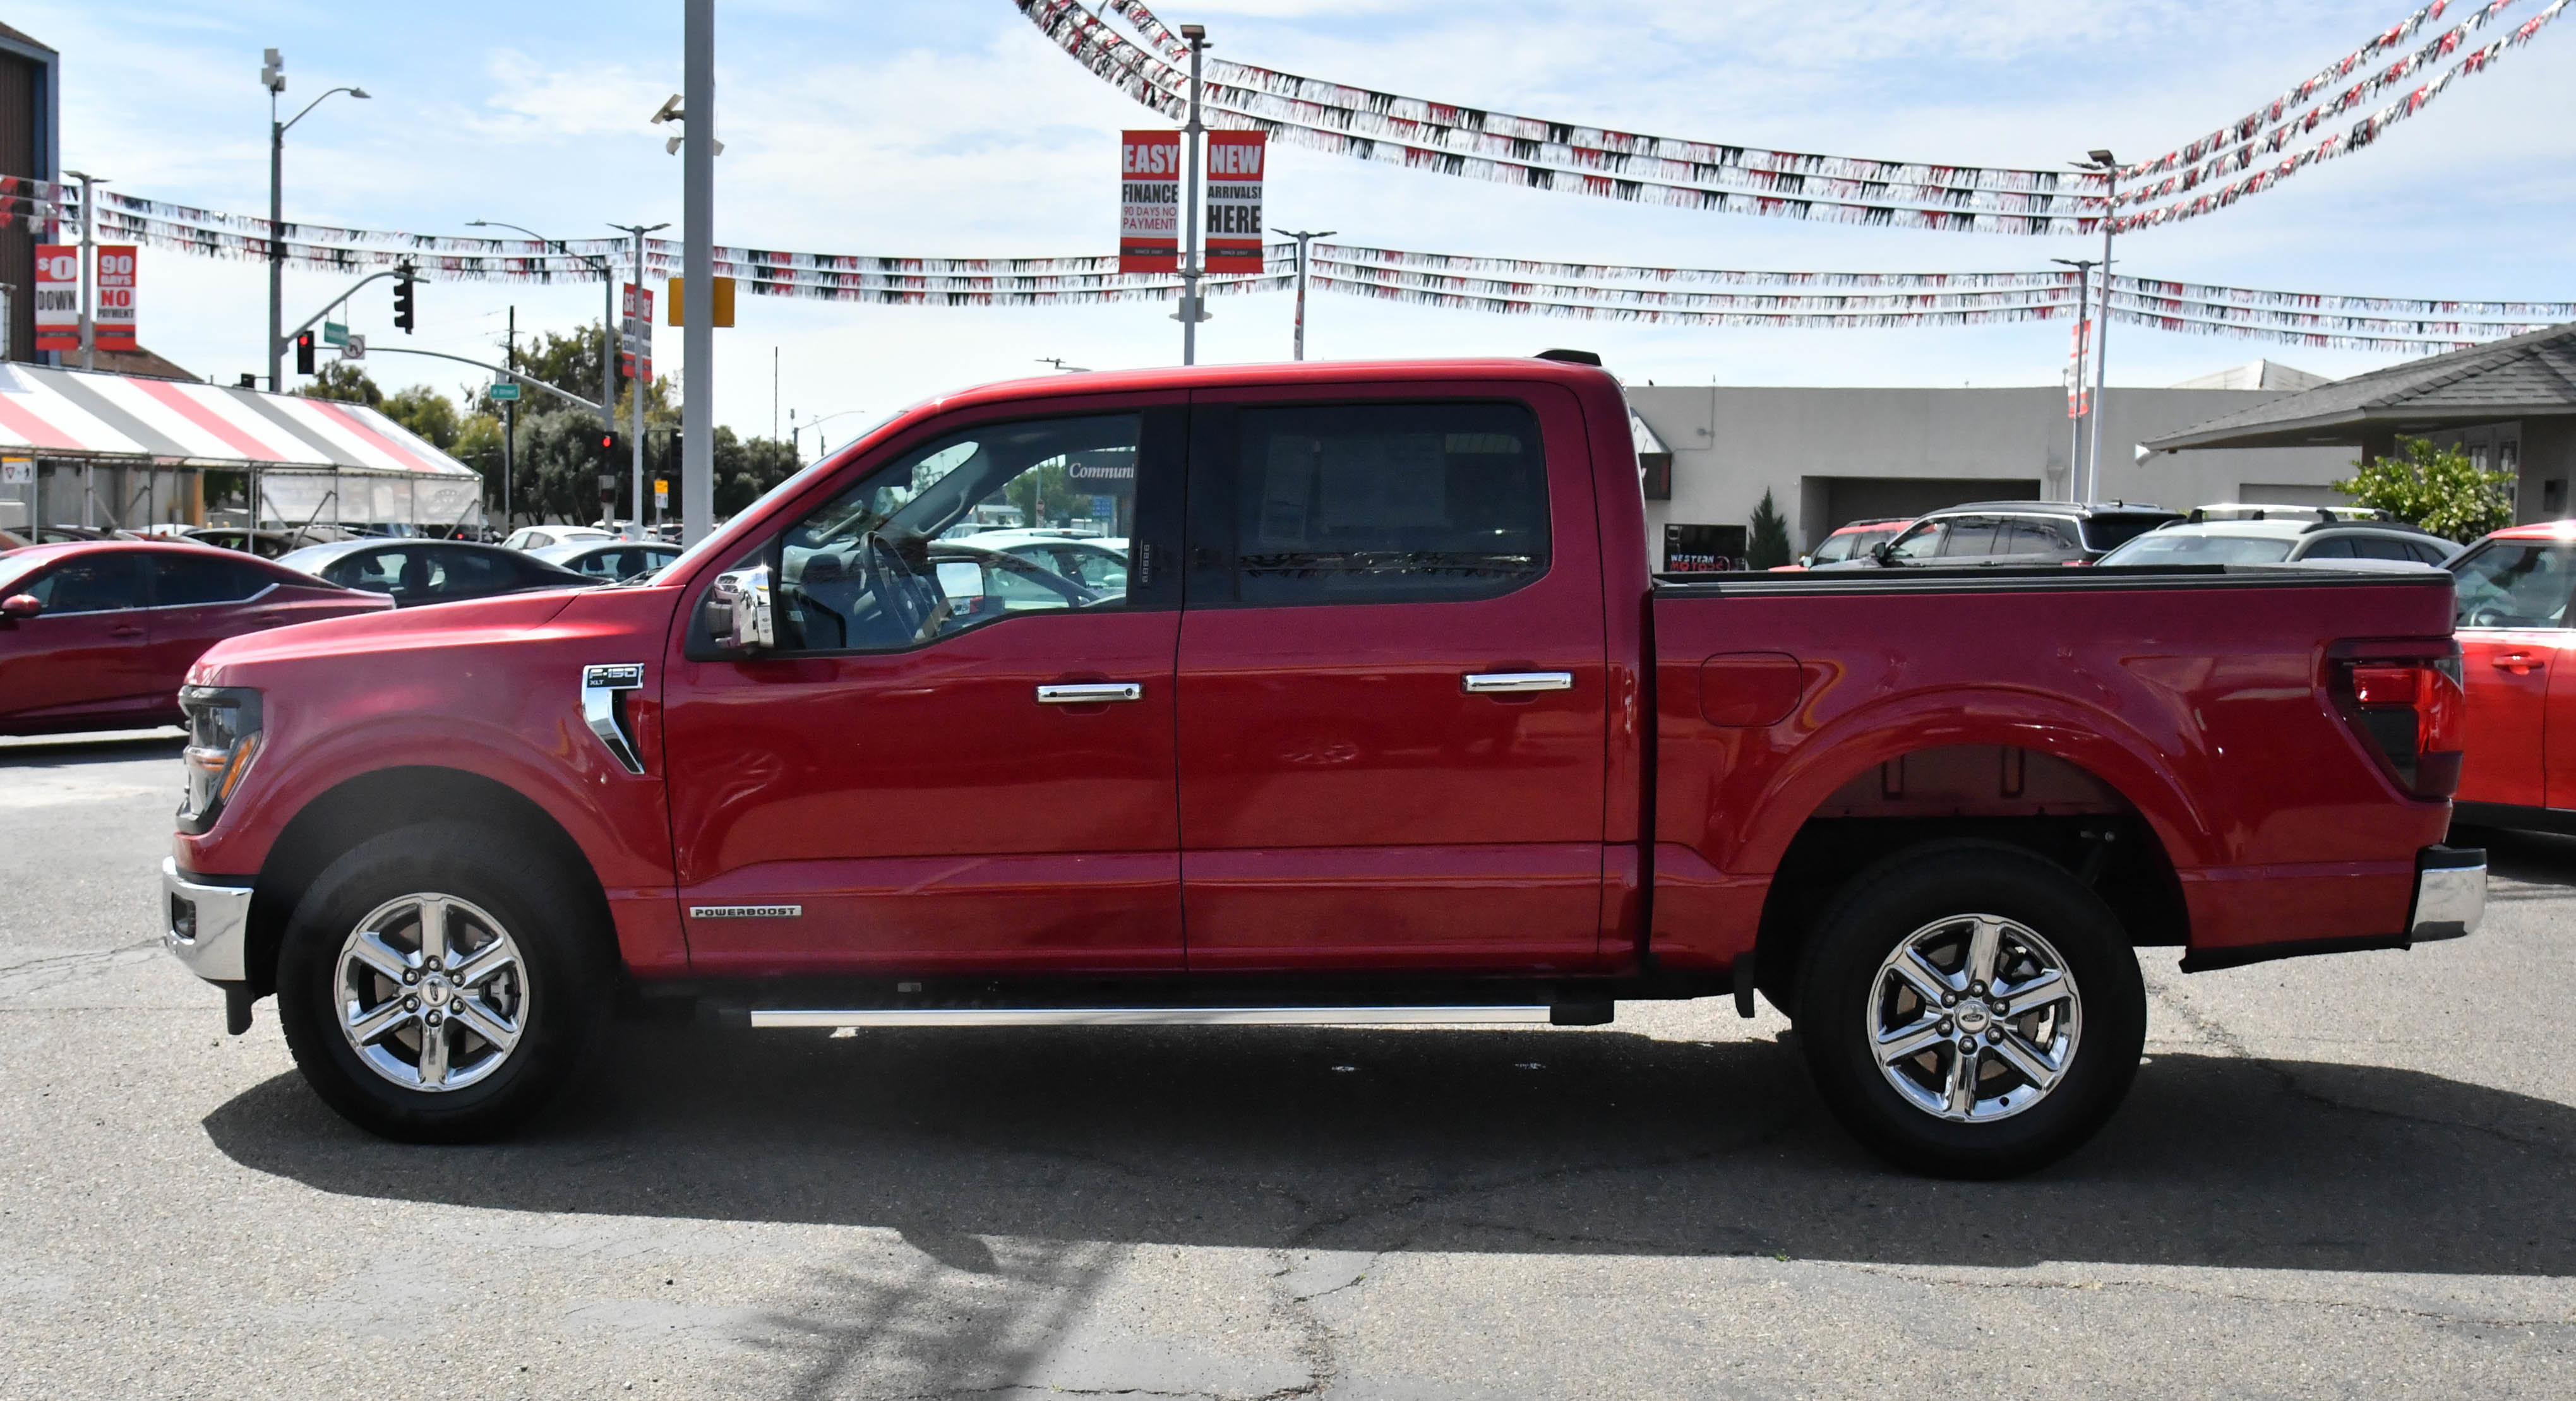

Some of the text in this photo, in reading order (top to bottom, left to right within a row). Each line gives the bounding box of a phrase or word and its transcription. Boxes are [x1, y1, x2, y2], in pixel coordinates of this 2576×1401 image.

[1123, 144, 1179, 174] EASY
[1210, 145, 1262, 174] NEW
[1122, 183, 1178, 204] FINANCE
[1207, 186, 1262, 199] ARRIVALS!
[1123, 206, 1177, 217] 90 DAYS NO
[1122, 218, 1177, 230] PAYMENT!
[1207, 205, 1261, 234] HERE
[38, 255, 76, 280] $0
[101, 254, 133, 275] 90
[101, 275, 132, 285] DAYS
[38, 290, 76, 311] DOWN
[101, 289, 131, 307] NO
[97, 309, 135, 318] PAYMENT
[1069, 462, 1134, 479] Communi
[1670, 561, 1725, 571] MOTORS
[1671, 554, 1715, 563] WESTERN
[589, 667, 637, 679] F-150
[695, 908, 796, 916] POWERBOOST
